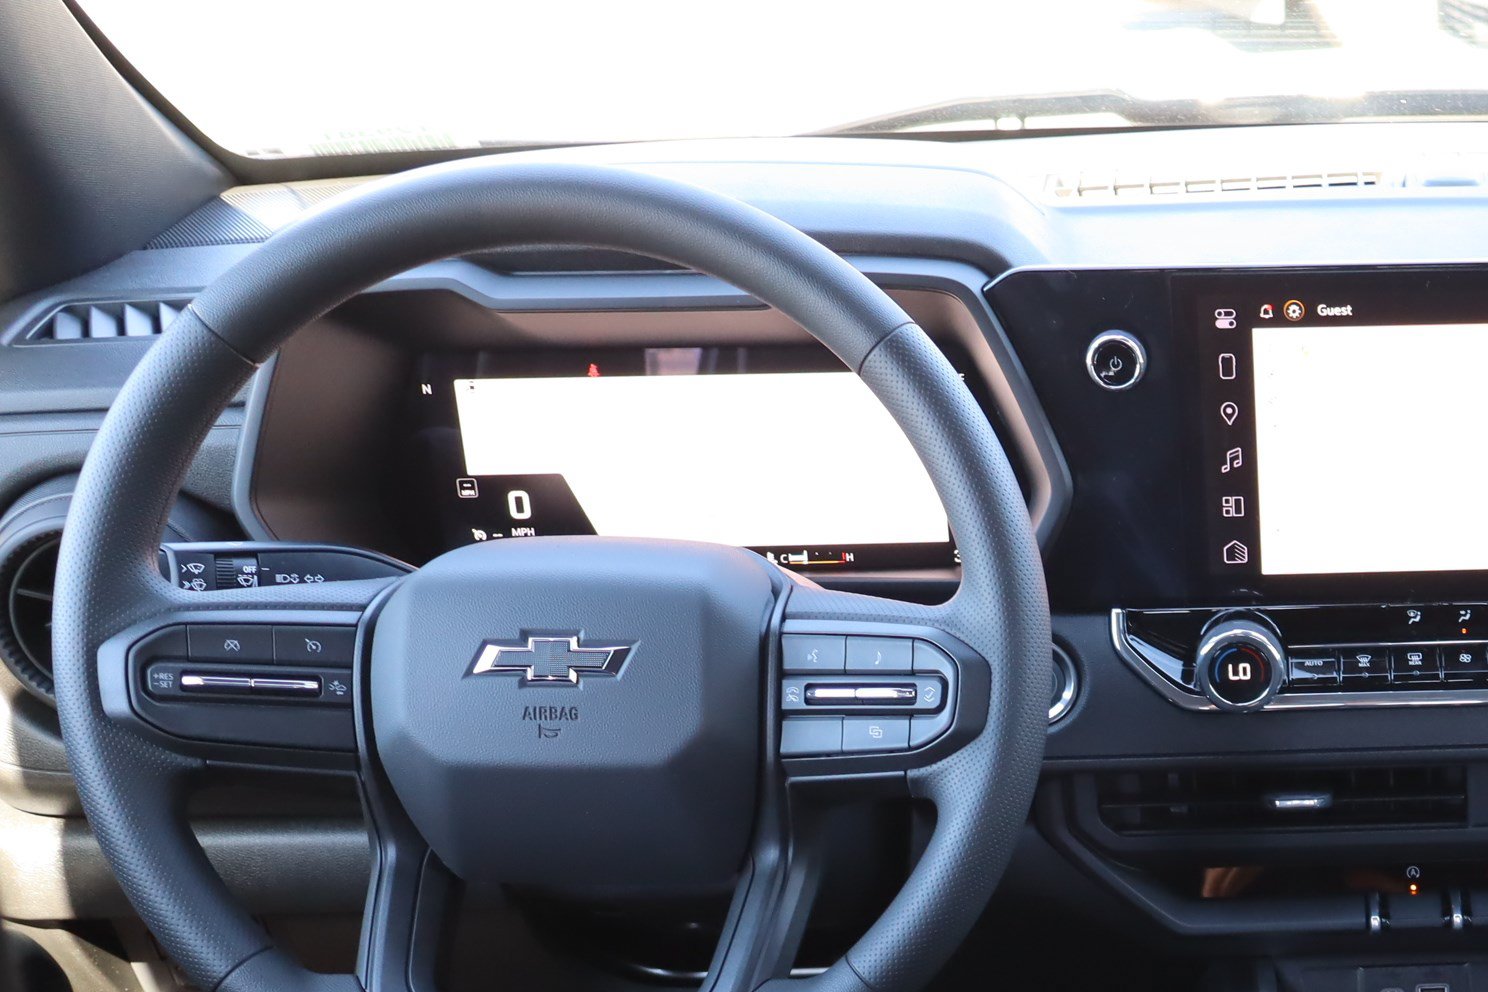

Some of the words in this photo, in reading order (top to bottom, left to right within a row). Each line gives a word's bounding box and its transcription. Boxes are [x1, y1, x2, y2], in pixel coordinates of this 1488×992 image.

[1317, 304, 1352, 316] Guest
[421, 383, 432, 395] N
[508, 490, 532, 520] 0
[511, 527, 535, 536] MPH
[780, 554, 788, 563] C
[846, 552, 854, 562] H
[242, 566, 257, 574] OFF
[1228, 663, 1251, 681] LO
[522, 706, 579, 721] AIRBAG
